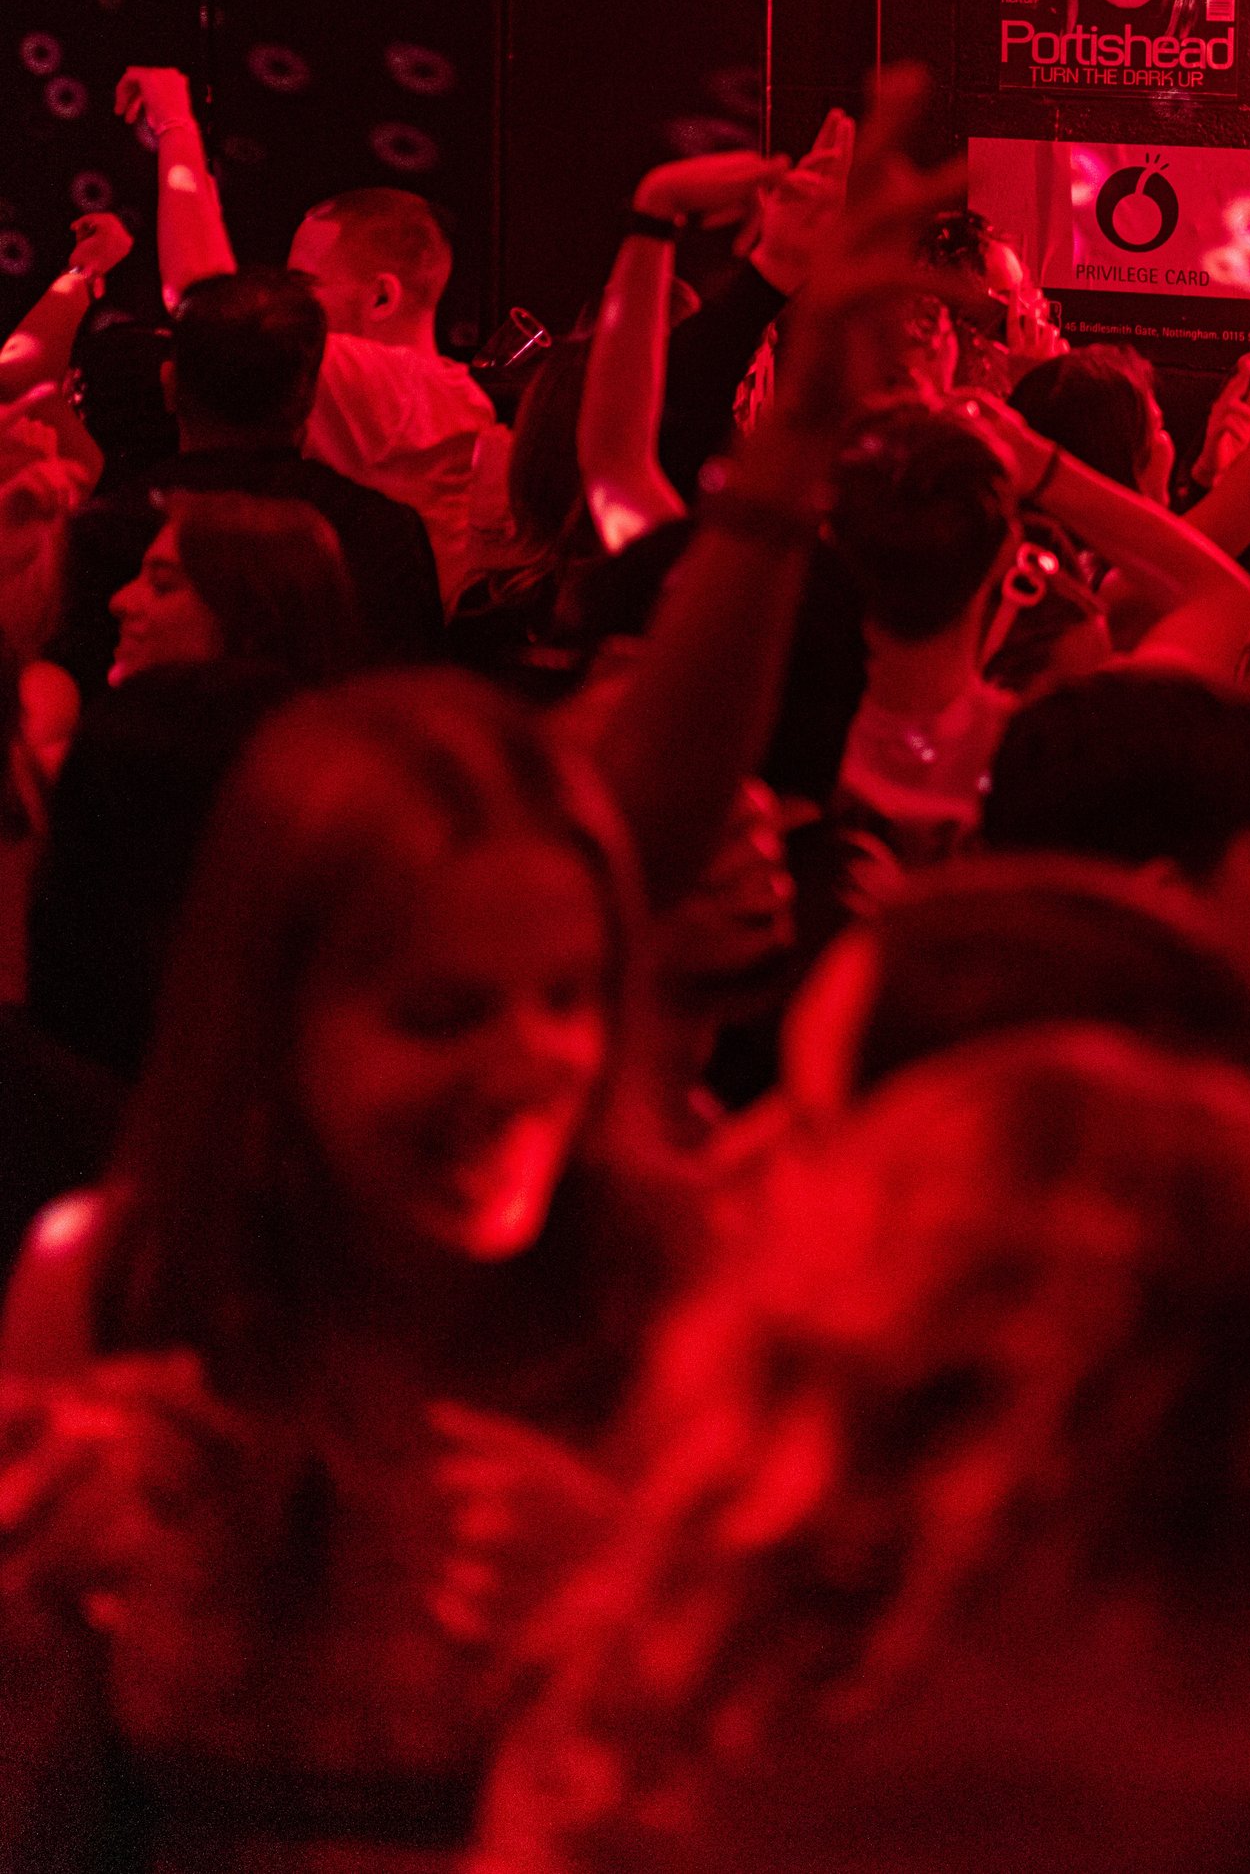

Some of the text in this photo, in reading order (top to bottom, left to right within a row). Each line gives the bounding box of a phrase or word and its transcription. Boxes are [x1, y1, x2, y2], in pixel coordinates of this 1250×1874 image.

[1001, 20, 1235, 70] Portishead
[1029, 66, 1079, 84] TURN
[1083, 68, 1118, 85] THE
[1123, 69, 1174, 87] DARK
[1075, 264, 1211, 287] PRIVILEGE CARD
[1079, 322, 1132, 335] Bridlesmith
[1135, 324, 1159, 338] Gate,
[1162, 326, 1220, 343] Nottingham.
[1222, 330, 1245, 342] 0115
